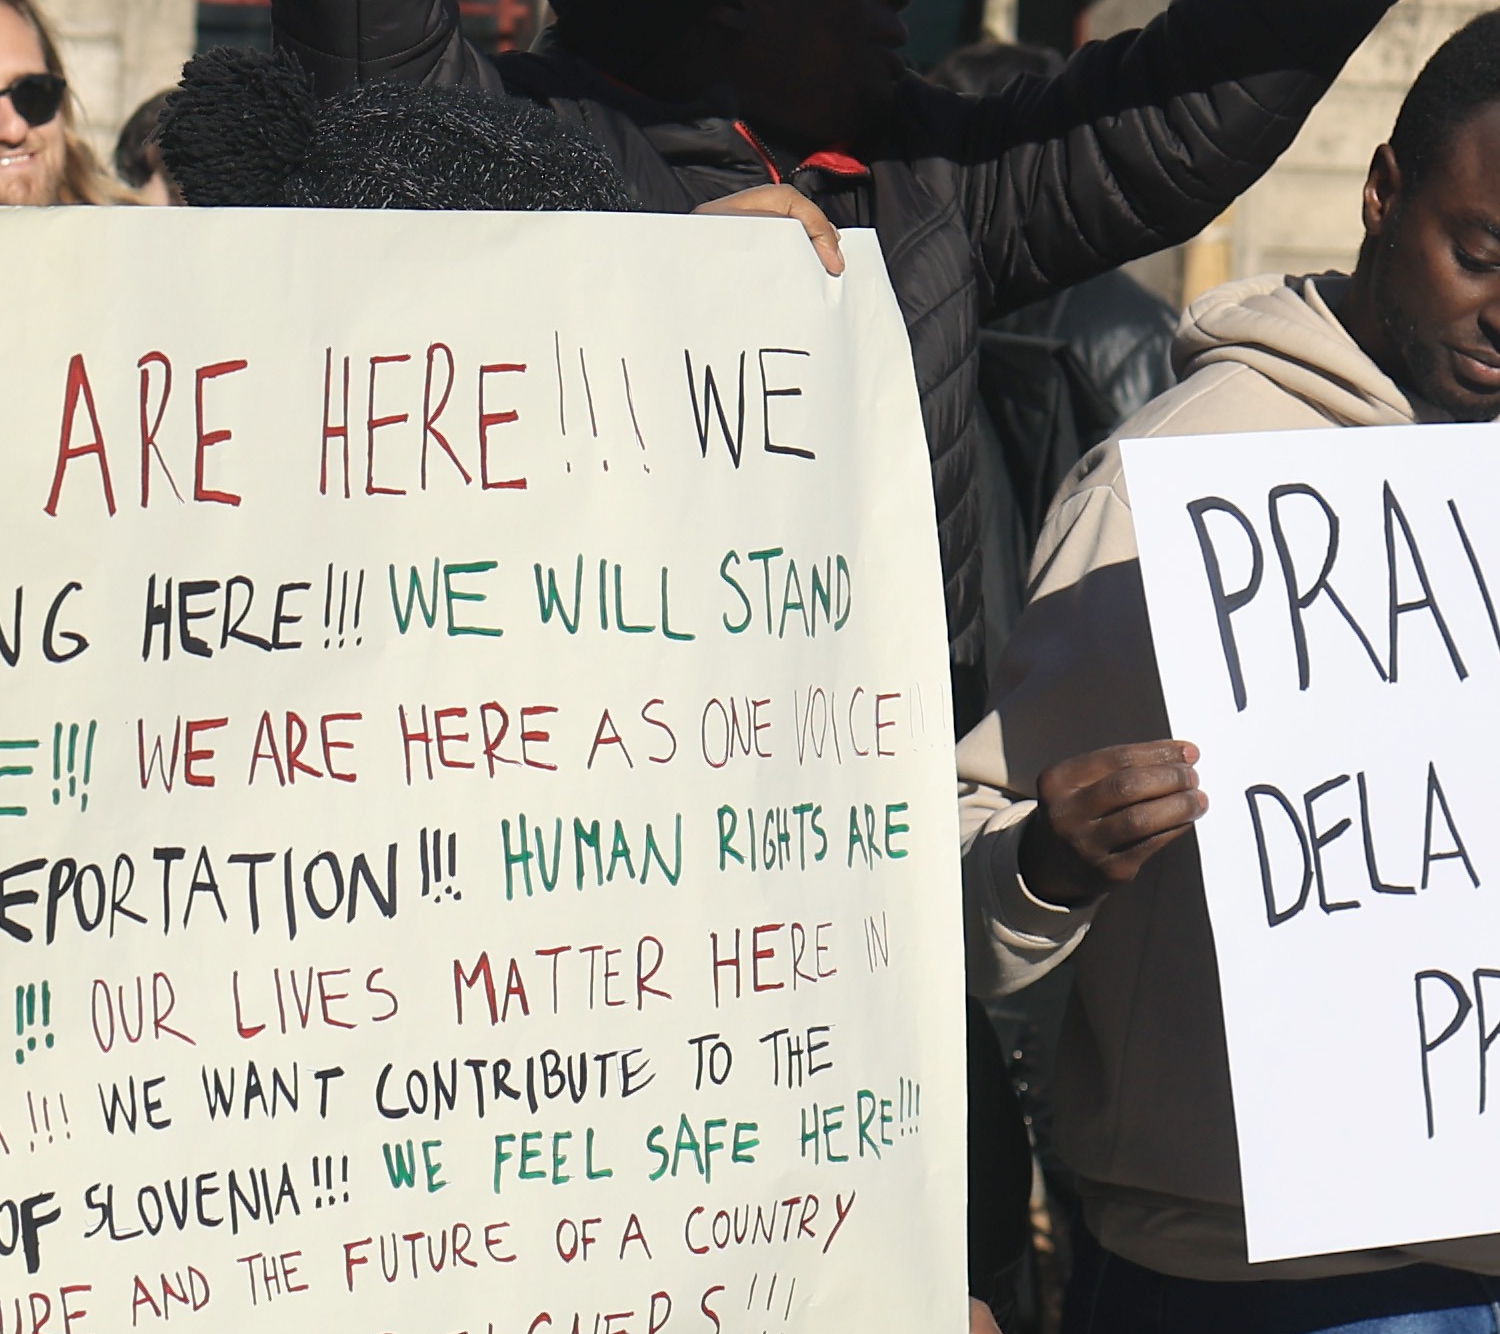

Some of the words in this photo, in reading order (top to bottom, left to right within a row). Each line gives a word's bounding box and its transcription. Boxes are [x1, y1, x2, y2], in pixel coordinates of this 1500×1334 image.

[43, 351, 248, 517] ARE
[685, 348, 816, 469] WE
[389, 557, 503, 637] WE
[534, 553, 696, 641] WILL
[720, 547, 851, 639] STAND
[138, 715, 228, 793] WE
[248, 710, 362, 787] ARE
[398, 701, 558, 786] HERE
[587, 699, 677, 769] AS
[702, 697, 772, 768] ONE
[501, 813, 681, 901] HUMAN
[717, 802, 827, 872] RIGHTS
[848, 802, 909, 870] ARE
[1244, 761, 1481, 928] DELA
[92, 972, 196, 1053] OUR
[233, 966, 398, 1039] LIVES
[454, 936, 672, 1026] MATTER
[710, 922, 837, 1008] HERE
[864, 911, 888, 973] IN
[98, 1075, 171, 1135] WE
[202, 1060, 345, 1121] WANT
[376, 1048, 656, 1120] CONTRIBUTE
[688, 1033, 732, 1091] TO
[759, 1026, 833, 1089] THE
[382, 1139, 448, 1193] WE
[494, 1128, 613, 1194] FEEL
[646, 1113, 760, 1184] SAFE
[132, 1266, 210, 1327] AND
[236, 1250, 309, 1306] THE
[343, 1221, 517, 1292] FUTURE
[556, 1217, 602, 1263] OF
[619, 1213, 652, 1260] A
[685, 1190, 855, 1254] COUNTRY
